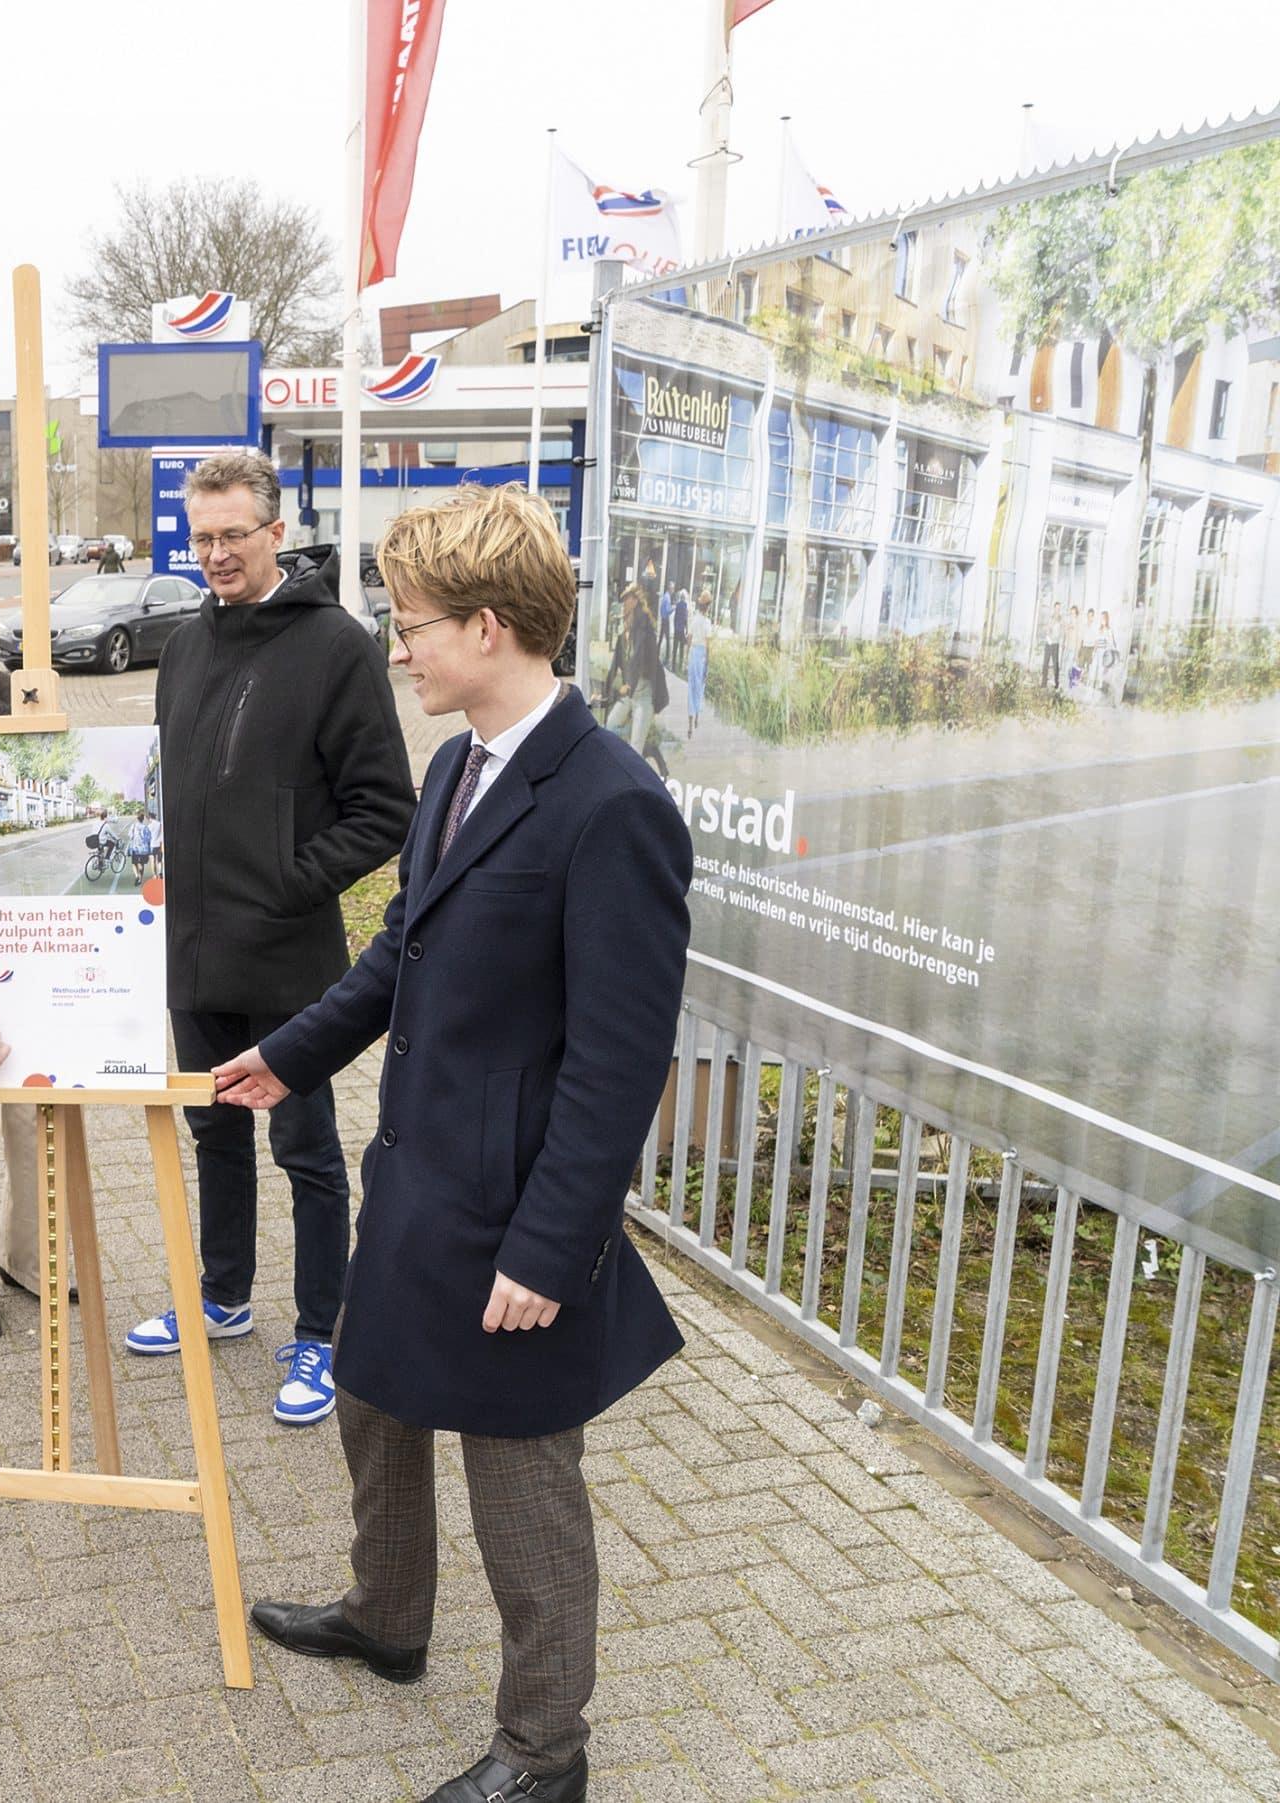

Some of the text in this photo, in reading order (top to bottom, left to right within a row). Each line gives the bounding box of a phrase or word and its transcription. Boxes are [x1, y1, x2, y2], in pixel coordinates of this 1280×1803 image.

[264, 377, 337, 406] OLIE
[159, 460, 185, 470] EURO
[913, 462, 955, 479] ALADIN
[662, 776, 809, 858] erstad.
[18, 911, 44, 921] van
[49, 908, 73, 921] het
[77, 908, 124, 921] Fieten
[693, 854, 995, 964] aast de historische binnenstad. Hier kan je
[57, 927, 84, 937] aan
[729, 889, 787, 922] winkelen
[789, 911, 806, 929] en
[808, 916, 841, 943] vrije
[843, 926, 869, 951] tijd
[872, 935, 979, 987] doorbrengen
